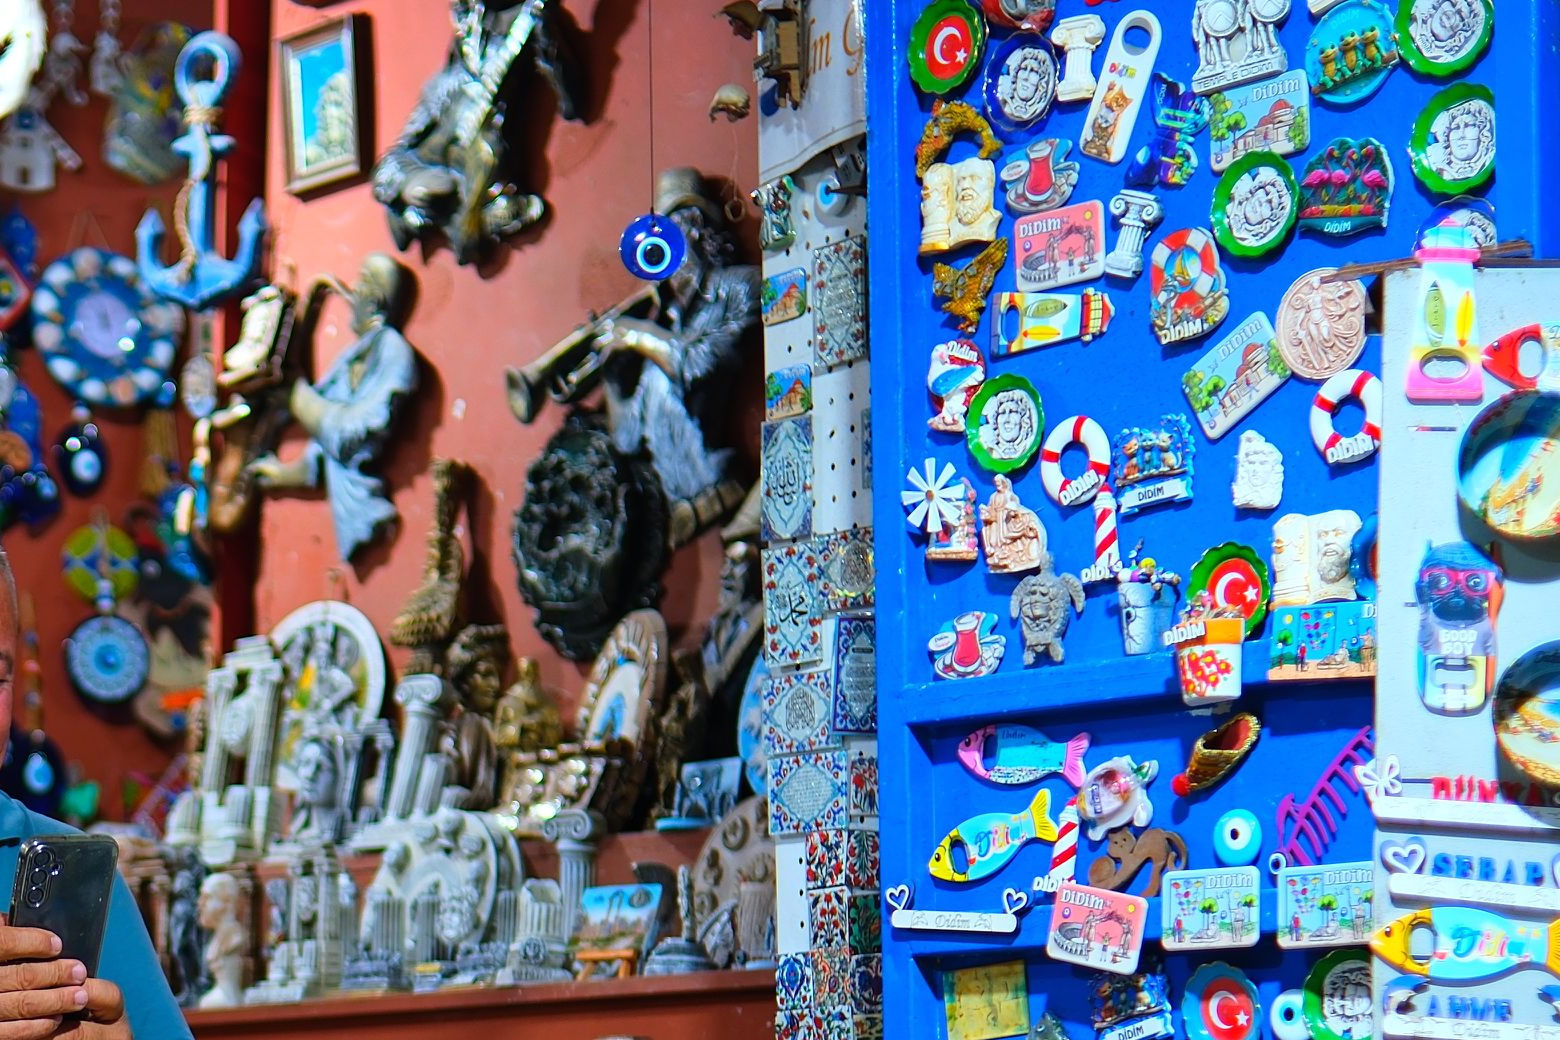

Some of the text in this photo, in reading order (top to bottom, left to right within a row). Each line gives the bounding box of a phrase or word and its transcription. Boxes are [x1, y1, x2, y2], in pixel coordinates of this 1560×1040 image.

[1197, 70, 1239, 90] TEMPLE
[1439, 629, 1478, 642] GOOD
[934, 913, 971, 929] Didim
